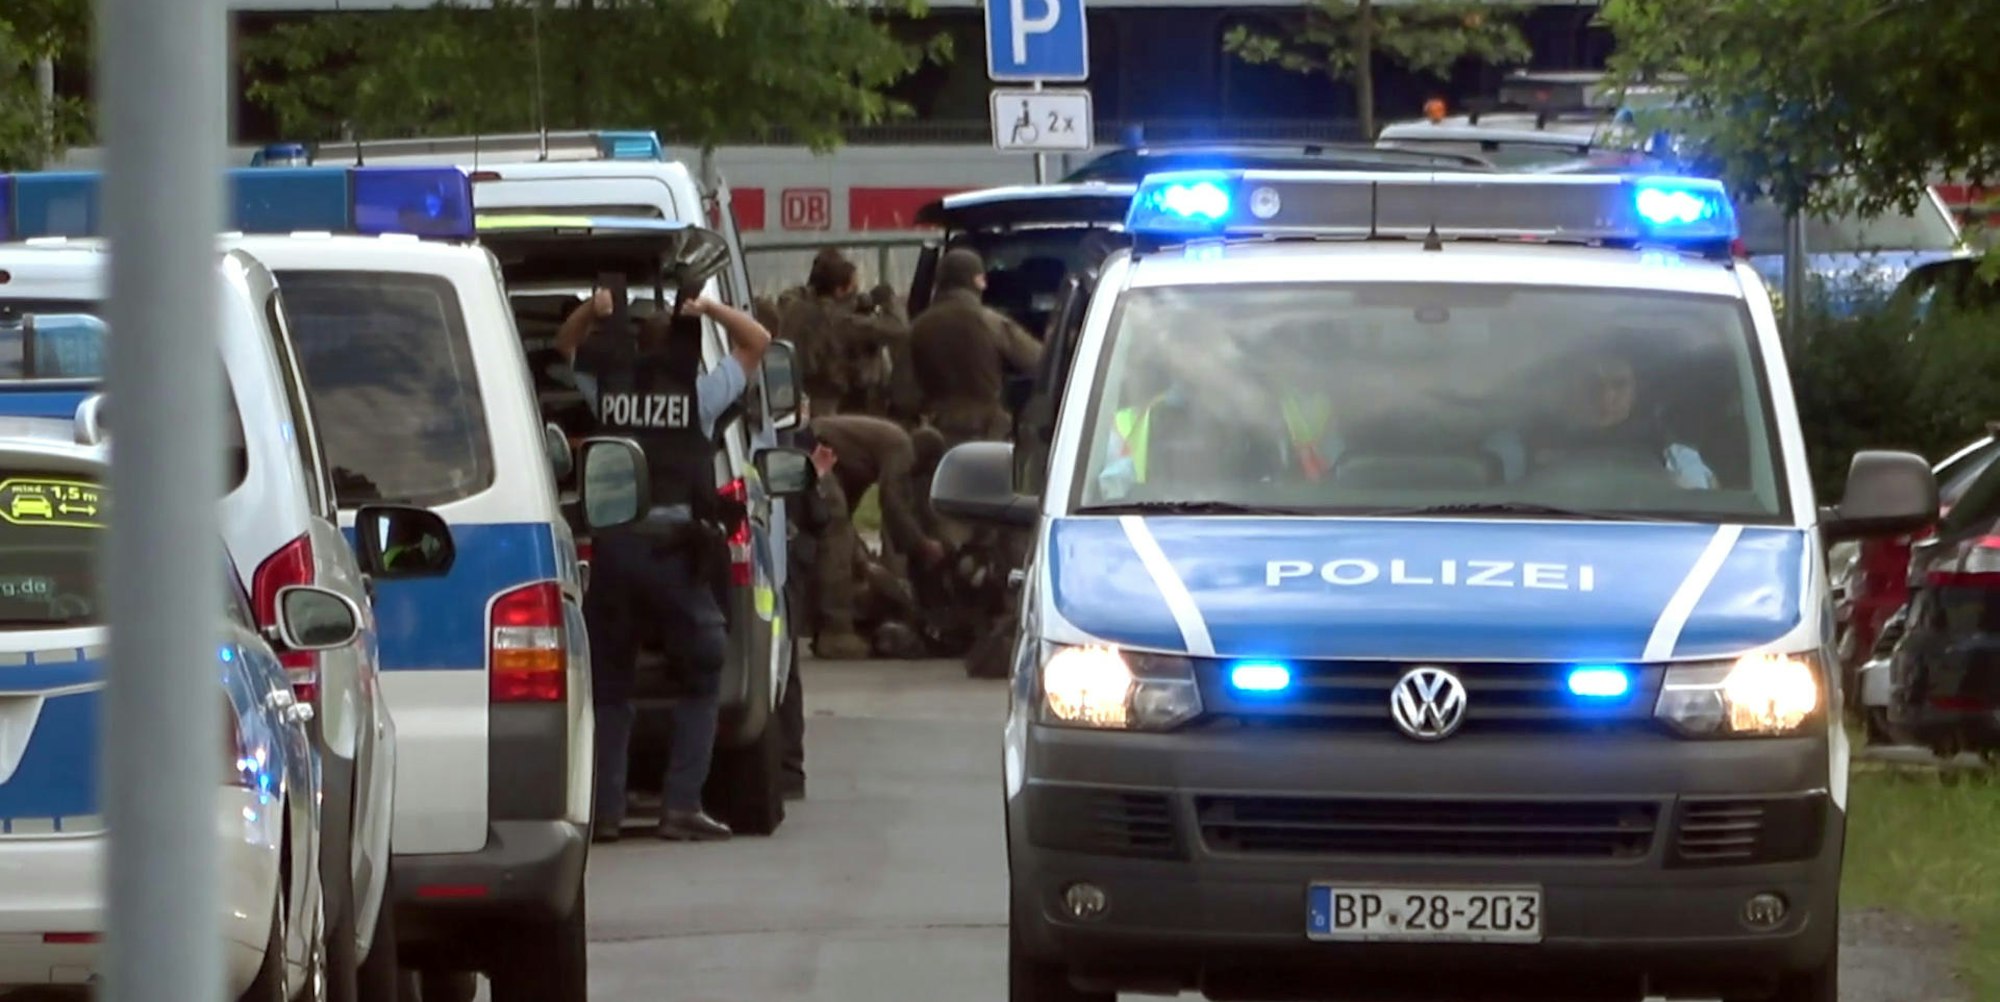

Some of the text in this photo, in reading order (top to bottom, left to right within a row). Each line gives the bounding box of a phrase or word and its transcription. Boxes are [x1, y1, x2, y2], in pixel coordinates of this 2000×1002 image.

[1010, 0, 1061, 65] P
[788, 196, 825, 222] DB
[602, 393, 690, 428] POLIZEI
[50, 485, 80, 501] 1,5
[1266, 559, 1594, 592] POLIZEI
[1391, 667, 1467, 740] VW
[1334, 893, 1537, 930] BP 28-203
